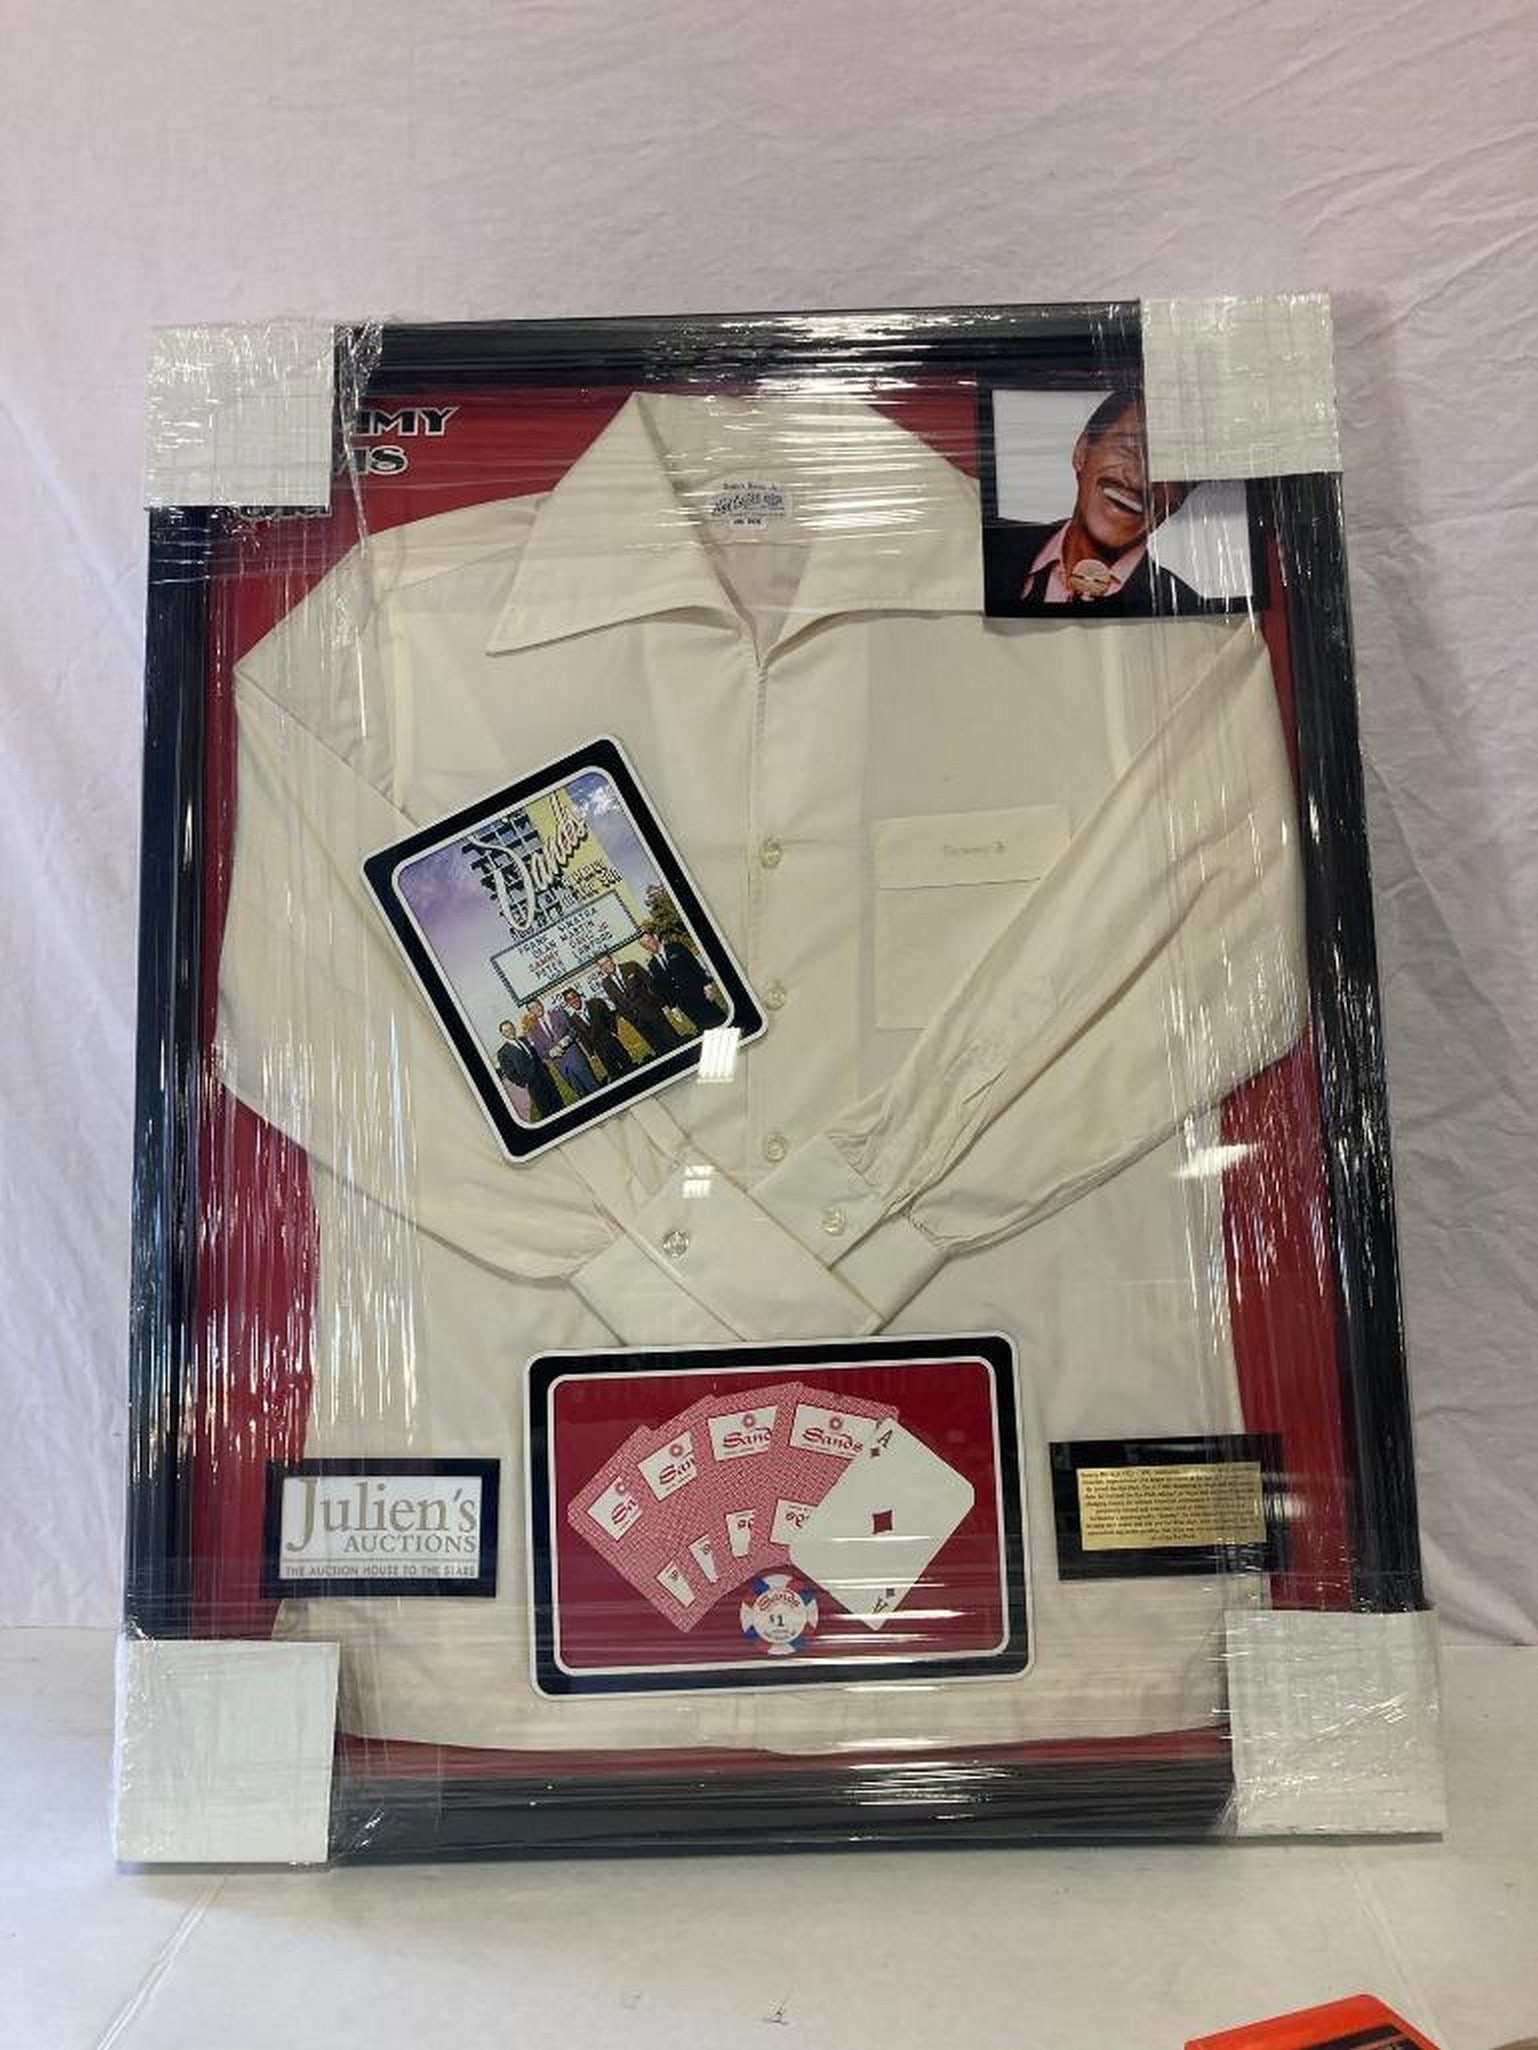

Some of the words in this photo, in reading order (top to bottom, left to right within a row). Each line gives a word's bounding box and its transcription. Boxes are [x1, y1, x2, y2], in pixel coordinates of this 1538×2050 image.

[353, 406, 460, 436] MY
[802, 1426, 863, 1451] Sands
[877, 1429, 893, 1448] A
[285, 1477, 478, 1552] Julien's
[343, 1534, 477, 1553] AUCTIONS
[285, 1565, 304, 1577] THE
[309, 1565, 359, 1576] AUCTION
[362, 1565, 398, 1576] HOUSE
[403, 1565, 417, 1576] TO
[422, 1565, 440, 1576] THE
[444, 1565, 475, 1577] STARS
